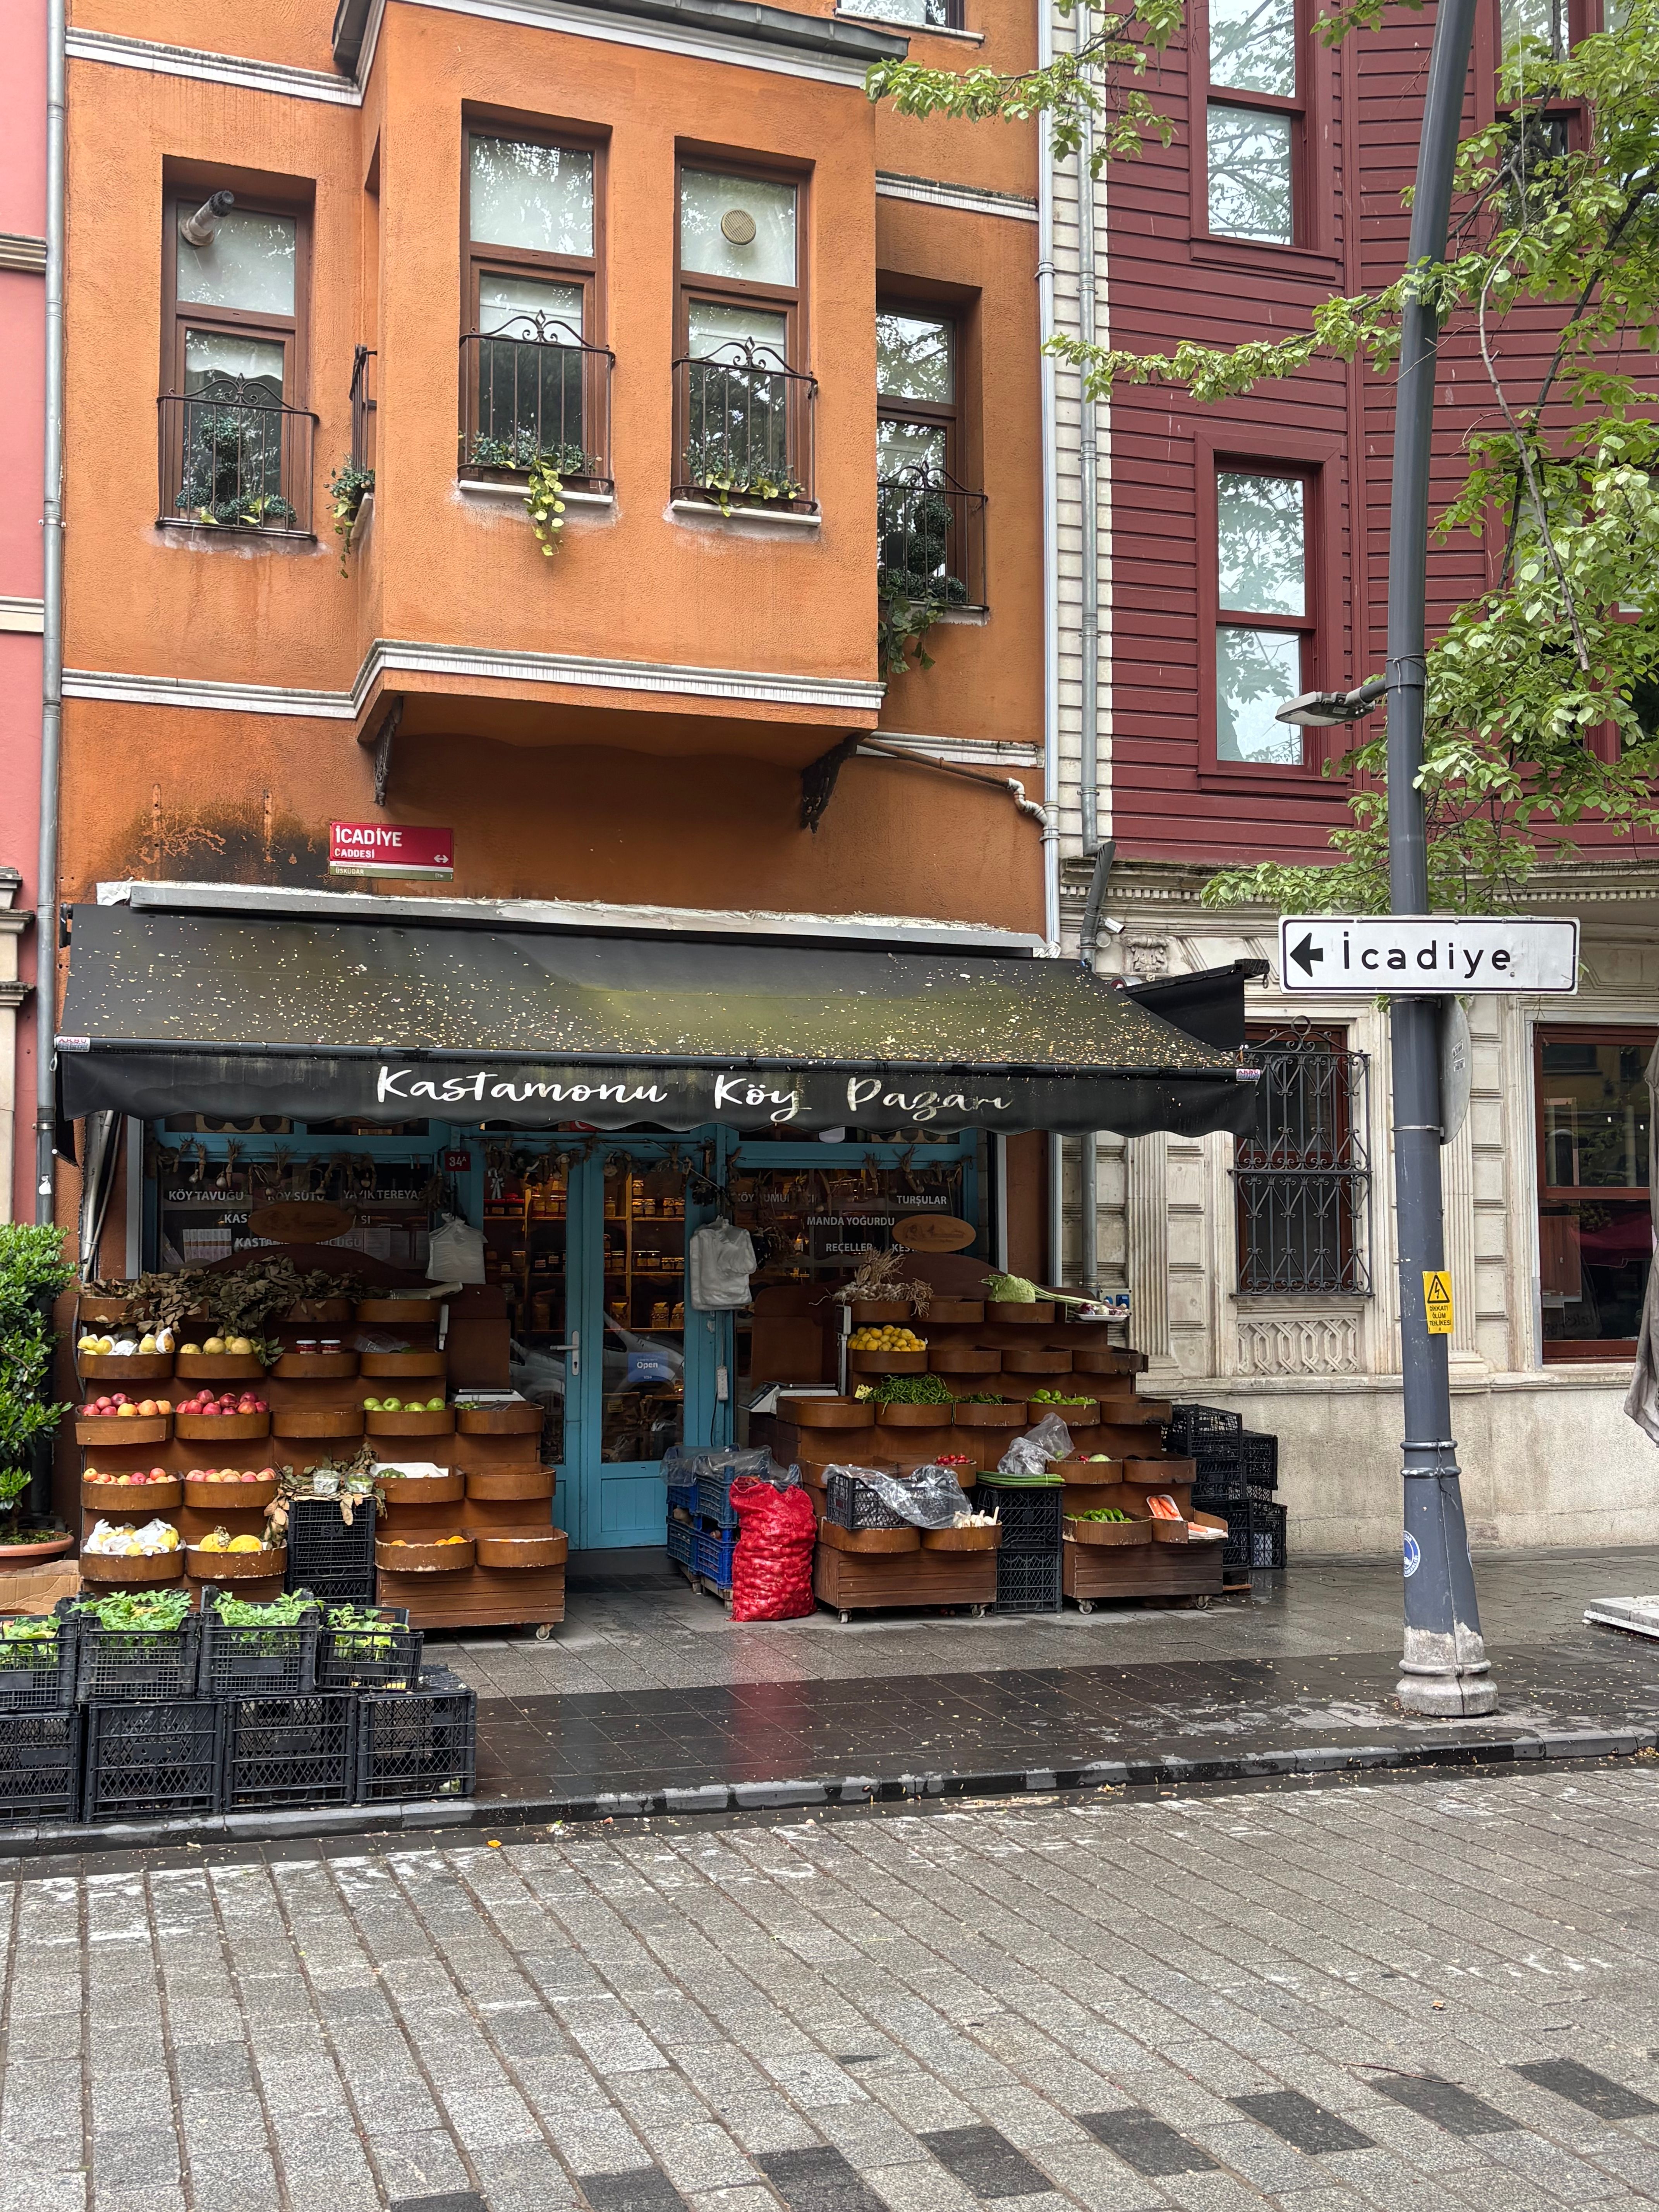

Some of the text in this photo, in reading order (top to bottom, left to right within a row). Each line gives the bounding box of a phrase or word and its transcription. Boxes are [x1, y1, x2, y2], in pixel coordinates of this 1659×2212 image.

[335, 825, 402, 847] İCADİYE
[334, 848, 375, 859] CADDESİ
[1343, 931, 1511, 979] İcadiye
[377, 1066, 668, 1103] Kastamonu
[714, 1075, 812, 1122] Köy
[169, 1189, 244, 1200] KÖY TAVUĞU
[896, 1195, 947, 1206] TURŞULAR
[807, 1215, 895, 1226] MANDA YOĞURDU
[826, 1243, 872, 1254] REÇELLER
